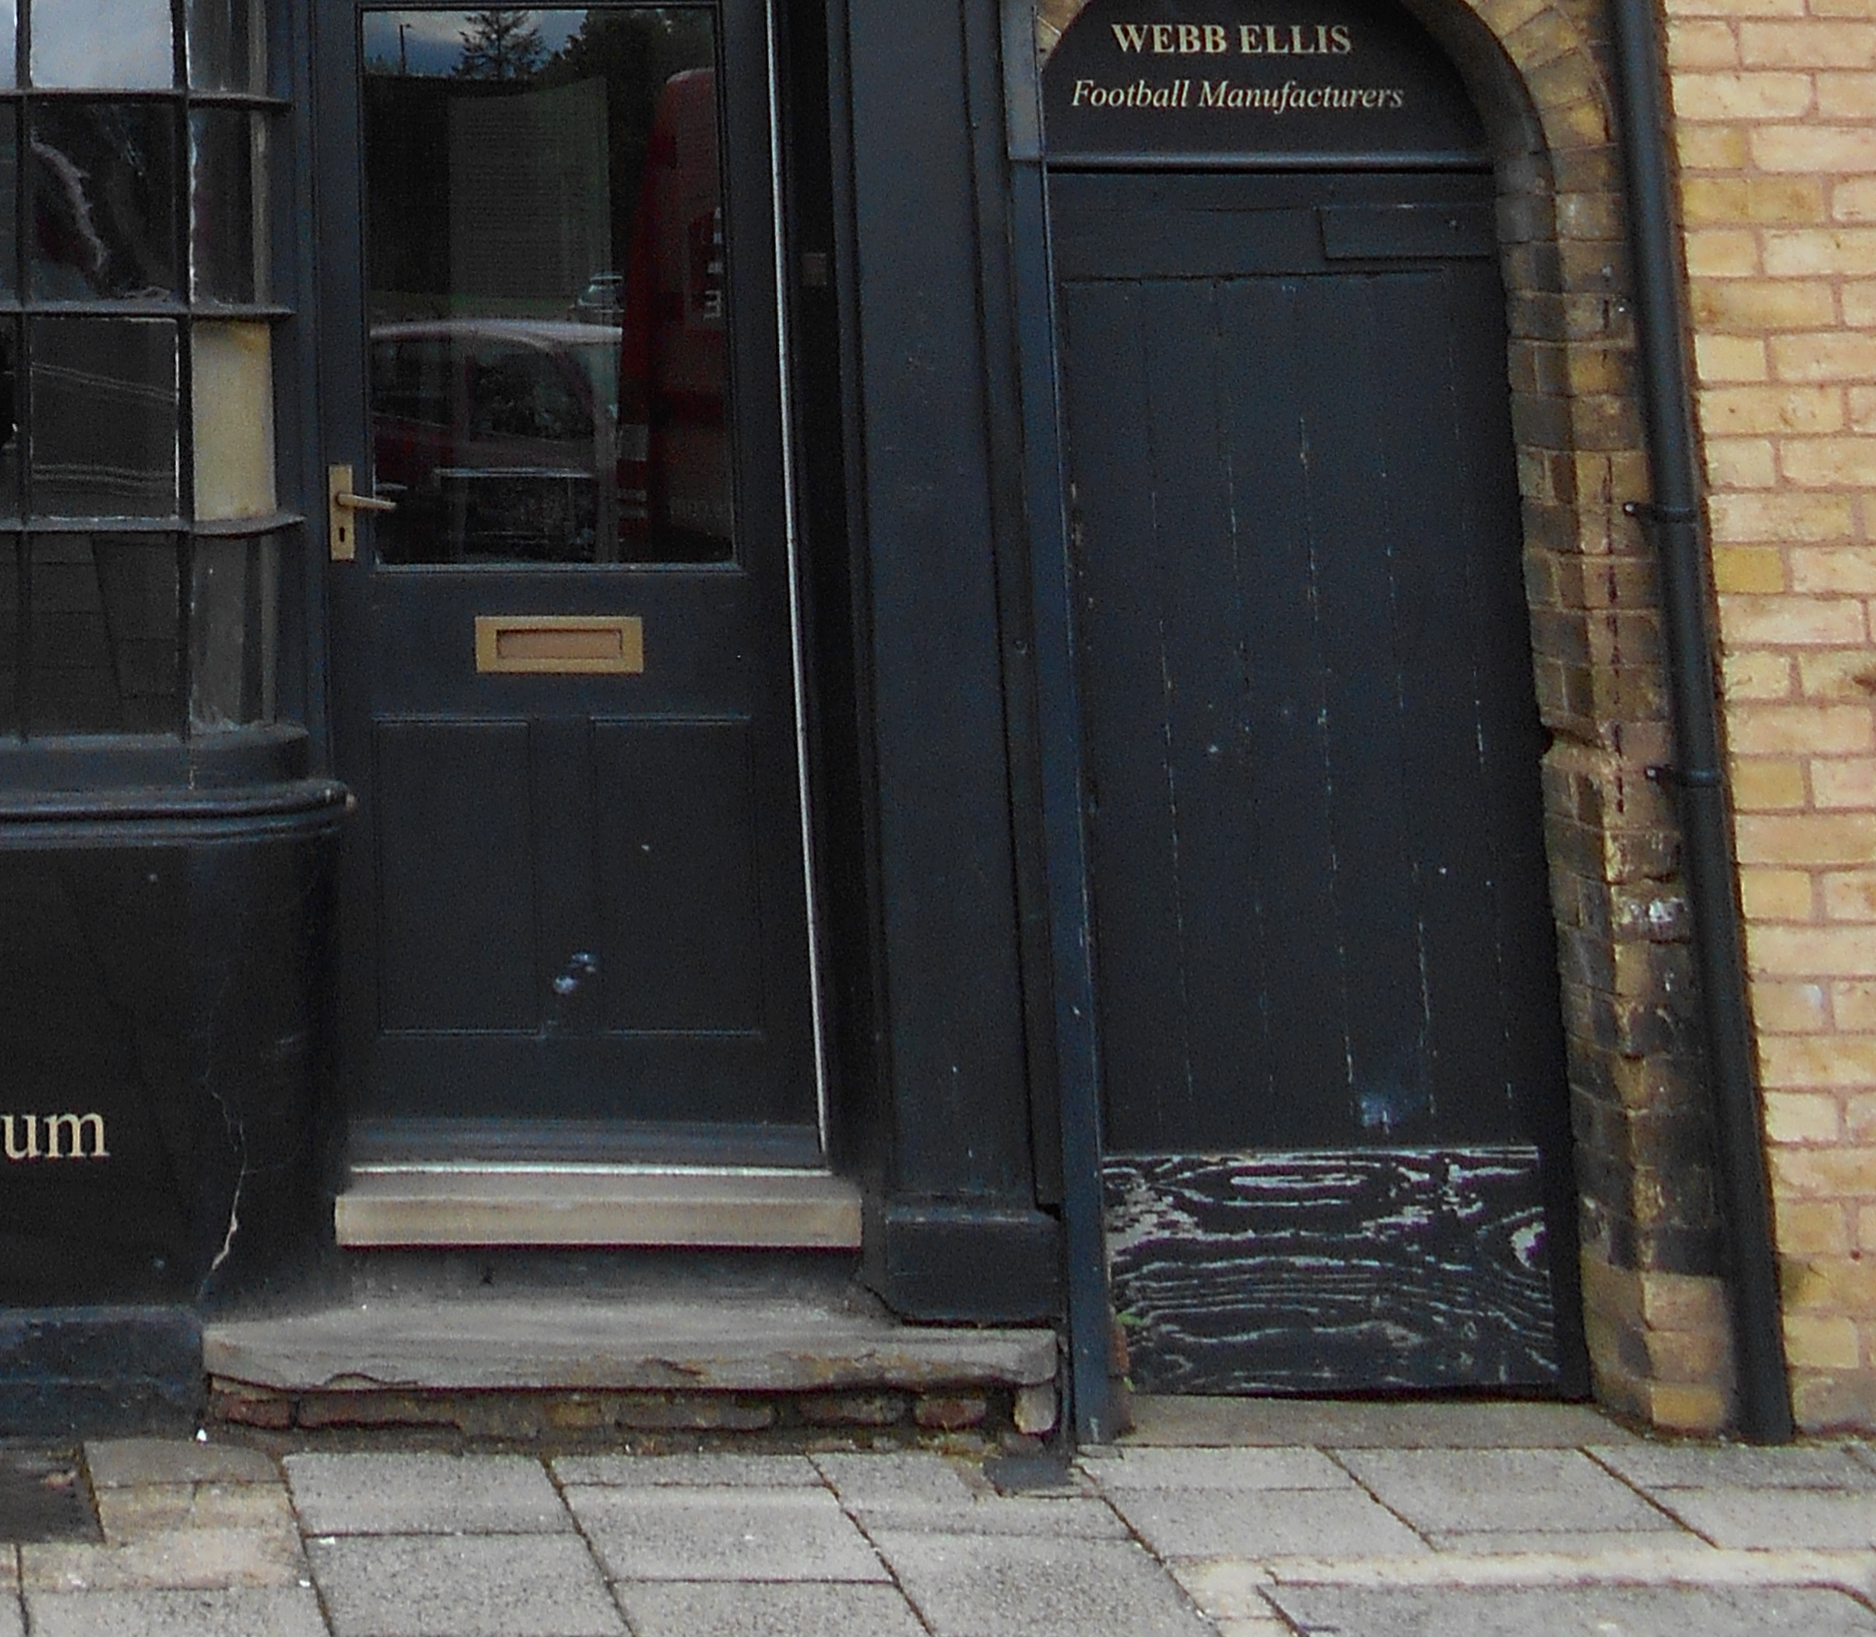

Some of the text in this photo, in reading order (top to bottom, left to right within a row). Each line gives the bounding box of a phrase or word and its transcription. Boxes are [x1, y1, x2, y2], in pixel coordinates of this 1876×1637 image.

[1111, 24, 1352, 54] WEBB ELLIS
[1071, 79, 1404, 115] Football Manufacturers
